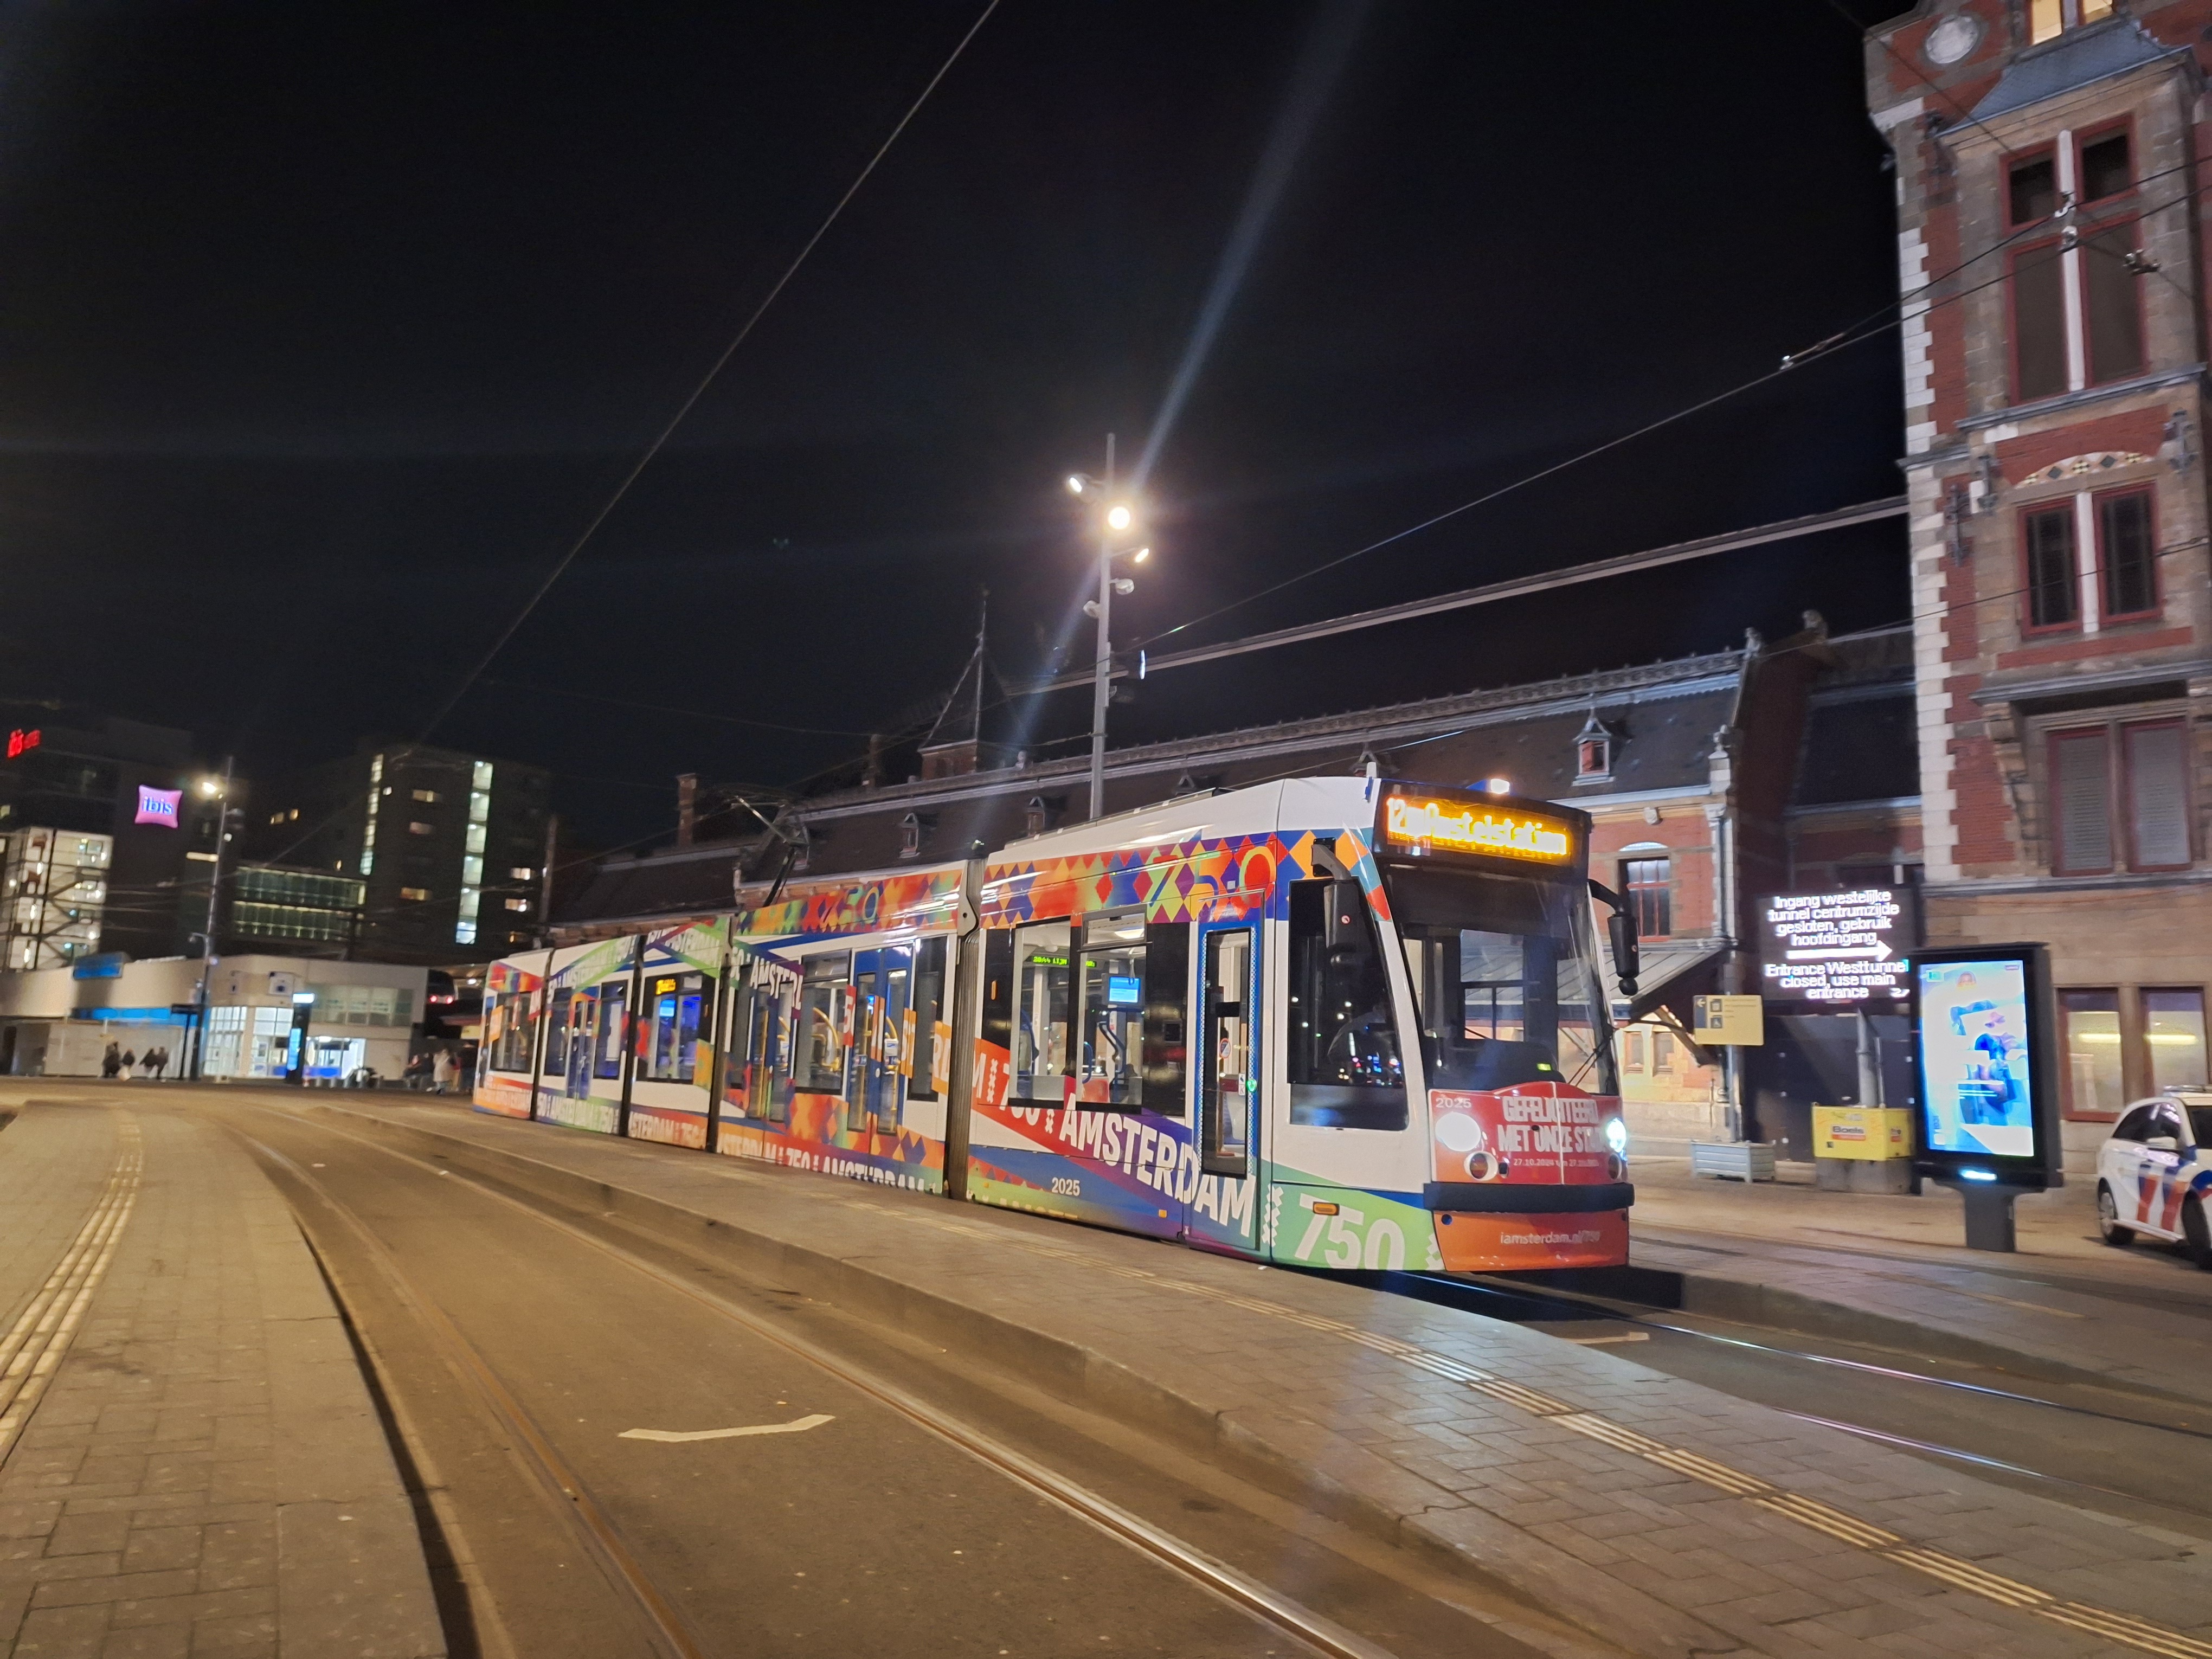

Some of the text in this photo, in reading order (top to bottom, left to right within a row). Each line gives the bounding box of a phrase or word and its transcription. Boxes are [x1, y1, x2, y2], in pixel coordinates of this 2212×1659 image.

[143, 796, 173, 815] ibis
[1773, 889, 1892, 910] Ingang westelijke
[1767, 903, 1900, 922] tunnel centrumzijde
[1775, 916, 1892, 937] gesloten, gebruik
[1790, 932, 1877, 947] hoofdingang
[1764, 959, 1909, 976] Entrance Westtunnel
[1780, 973, 1896, 988] closed, use main
[1805, 987, 1869, 999] entrance
[1436, 1098, 1472, 1109] 2025
[1497, 1124, 1530, 1152] MET
[1533, 1126, 1573, 1153] ONZE
[1832, 1126, 1864, 1134] Boels
[1060, 1093, 1257, 1237] AMSTERDAM
[1051, 1177, 1081, 1196] 2025
[1295, 1192, 1405, 1270] 750
